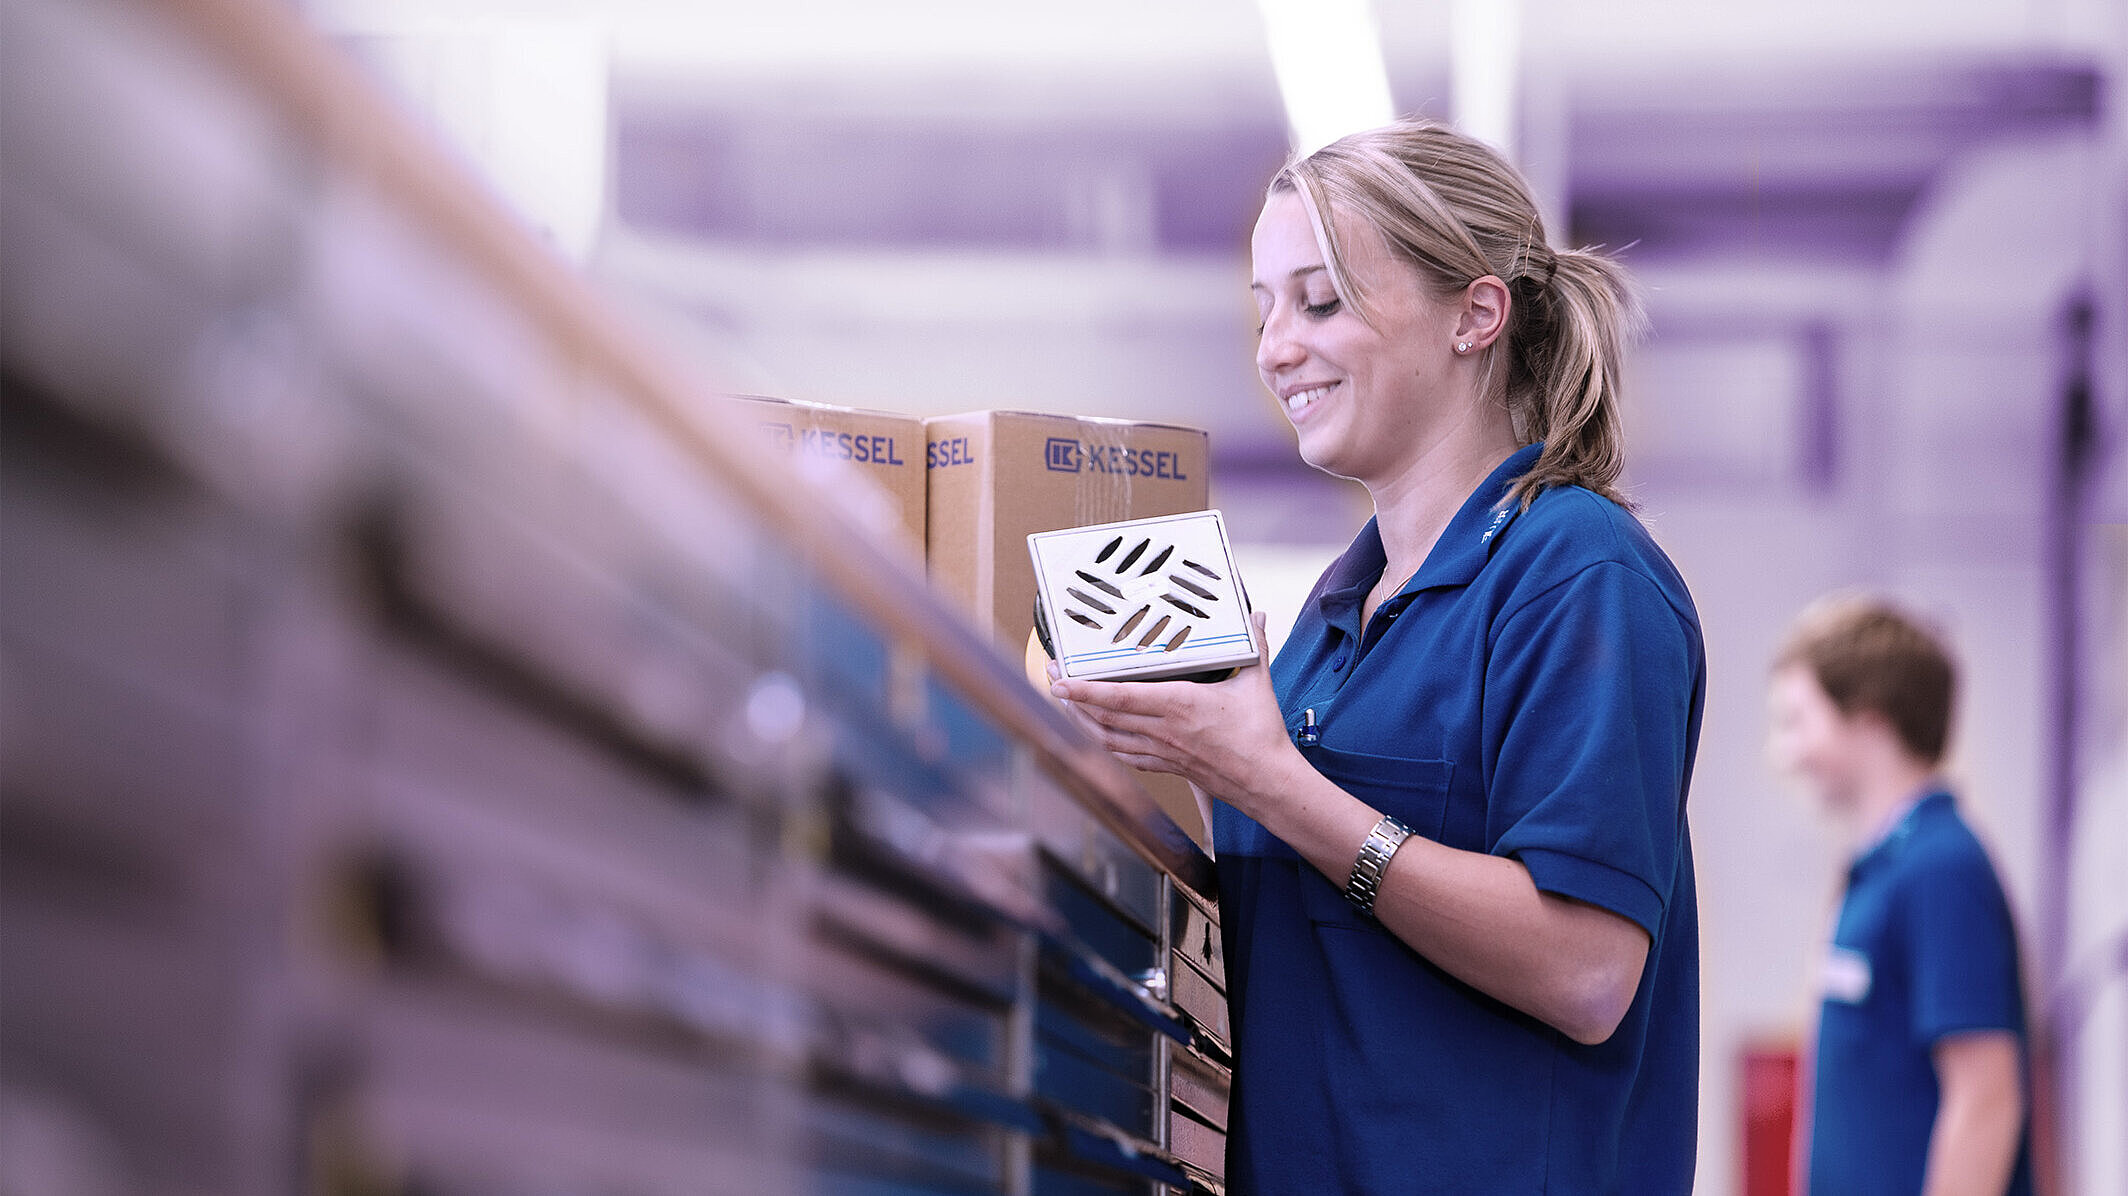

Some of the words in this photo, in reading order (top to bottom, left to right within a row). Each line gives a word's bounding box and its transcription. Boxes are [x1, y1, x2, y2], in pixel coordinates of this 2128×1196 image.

[801, 429, 903, 465] KESSEL
[928, 438, 974, 469] SSEL
[1089, 445, 1187, 480] KESSEL
